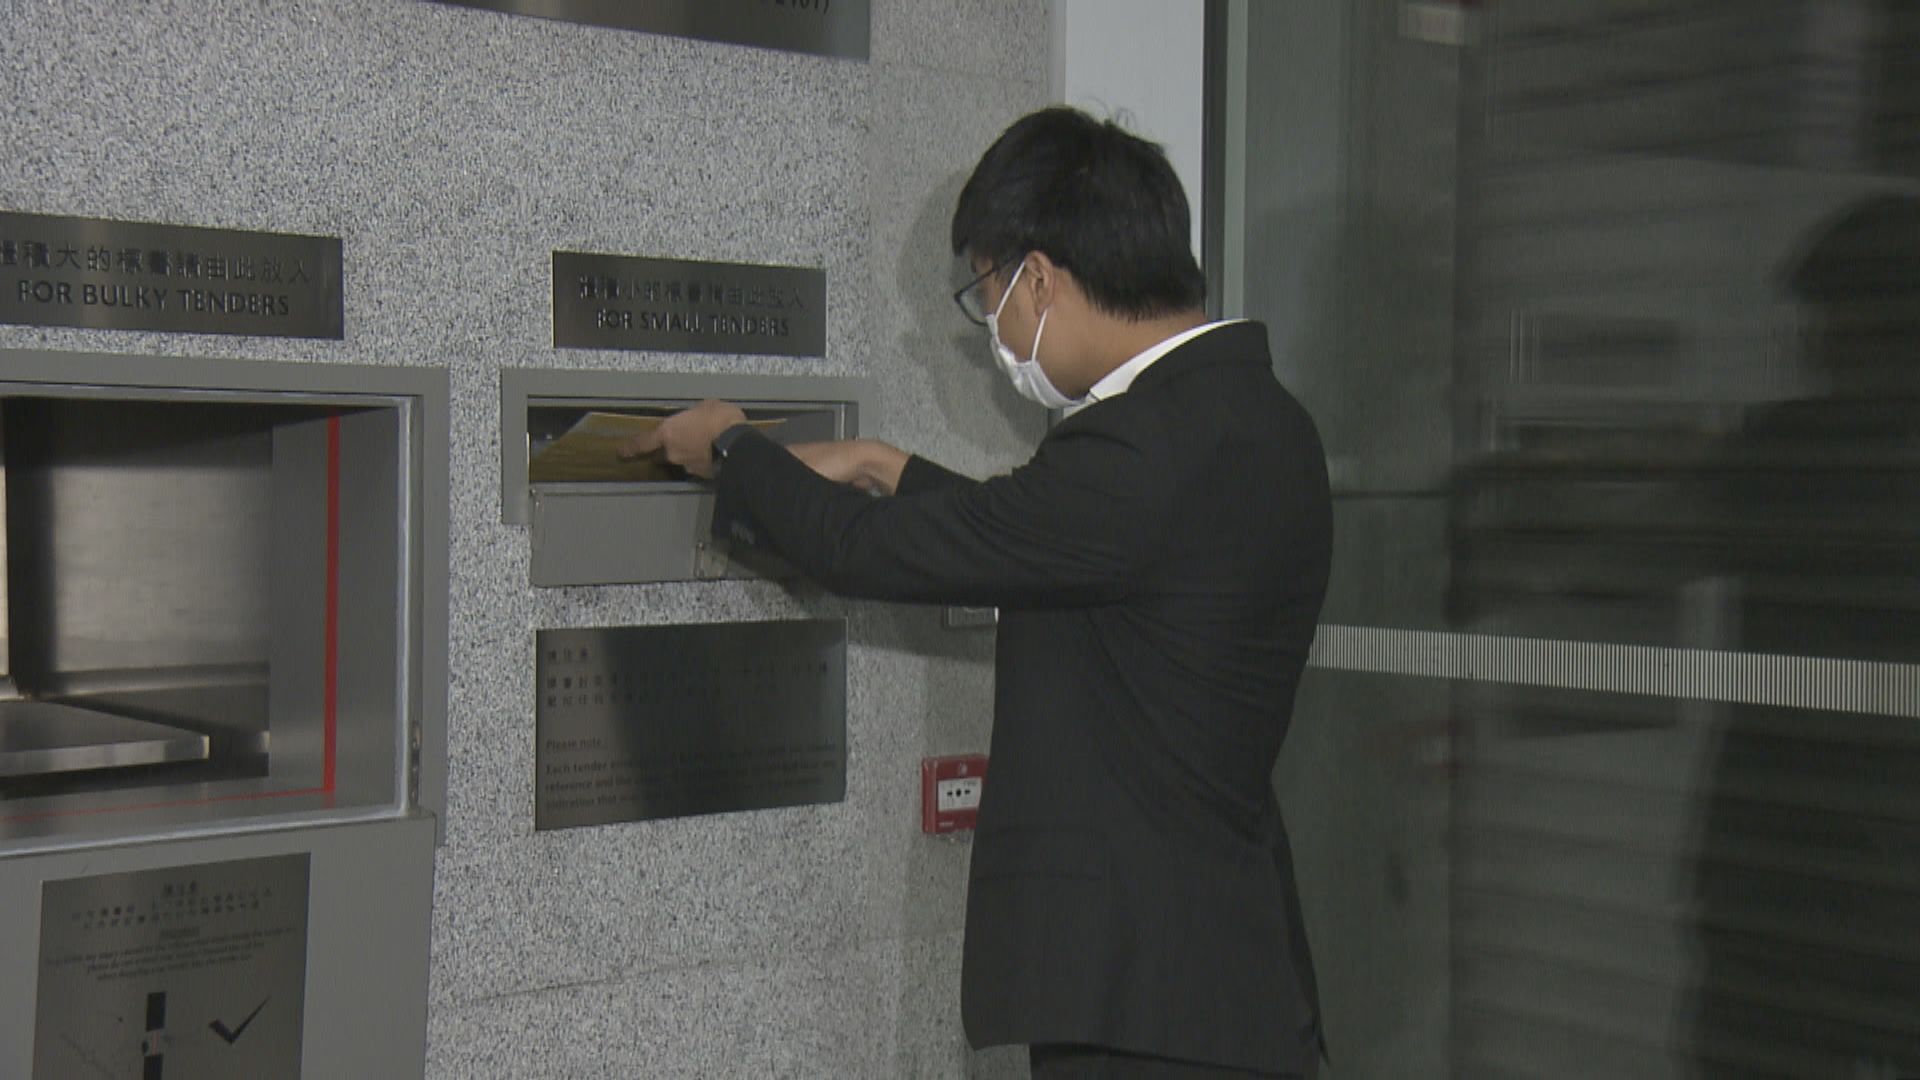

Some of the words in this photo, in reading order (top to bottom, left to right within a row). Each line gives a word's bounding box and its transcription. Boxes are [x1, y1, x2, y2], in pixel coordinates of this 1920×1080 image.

[18, 279, 73, 305] FOR
[82, 283, 169, 312] BULKY
[176, 288, 289, 316] TENDERS
[596, 309, 632, 330] FOR
[640, 311, 704, 334] SMALL
[709, 314, 789, 336] TENDERS
